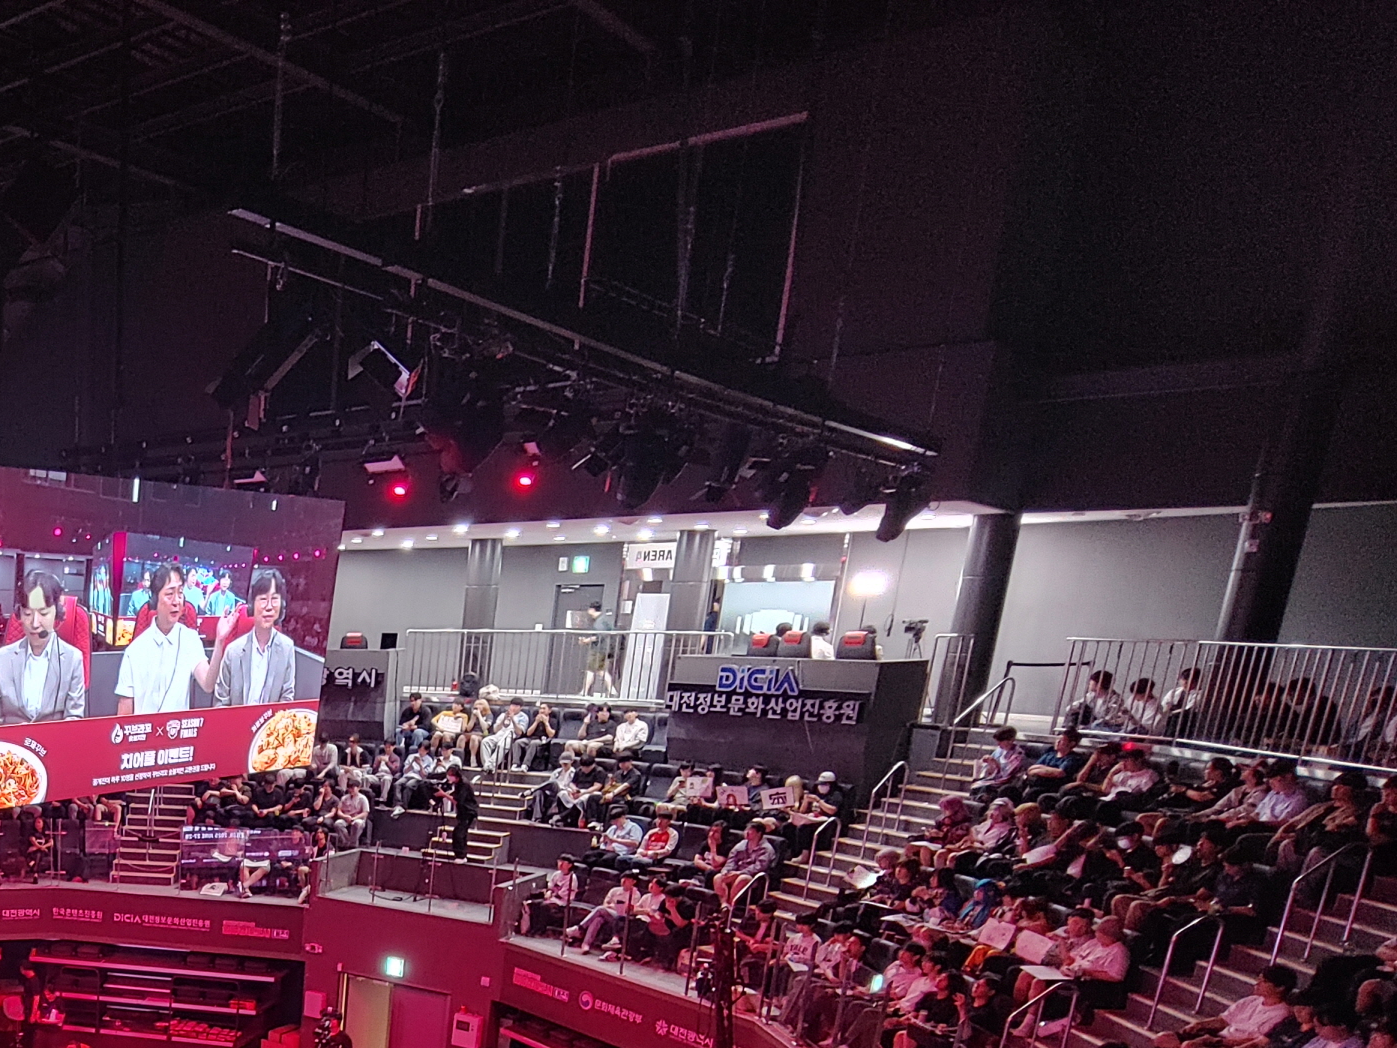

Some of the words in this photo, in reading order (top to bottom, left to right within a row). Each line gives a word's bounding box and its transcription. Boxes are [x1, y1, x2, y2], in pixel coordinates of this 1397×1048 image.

[323, 667, 376, 688] 역시
[666, 690, 860, 725] 대전정보문화산업진흥원
[120, 750, 156, 770] 치어풀
[157, 746, 195, 765] 이벤트!
[2, 908, 40, 918] 대전광역시
[594, 999, 642, 1024] 문화체육관광부
